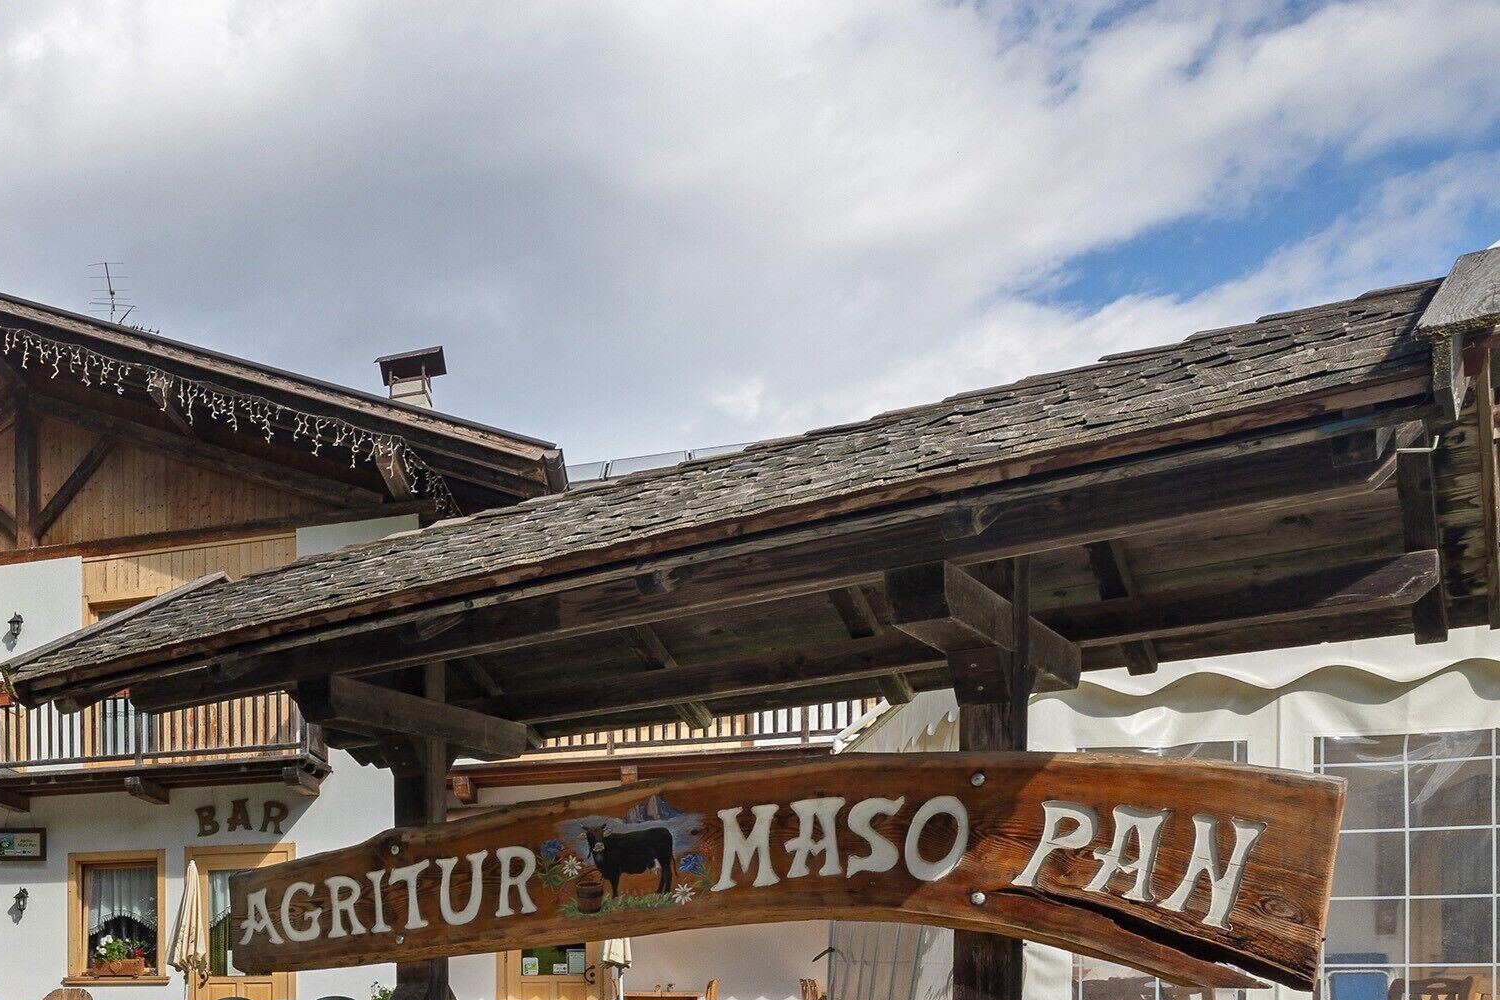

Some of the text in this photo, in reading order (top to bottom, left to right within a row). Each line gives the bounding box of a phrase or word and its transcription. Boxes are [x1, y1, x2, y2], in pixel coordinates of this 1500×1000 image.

[194, 798, 288, 837] BAR
[238, 795, 1268, 945] AGRITUR MASO PAN
